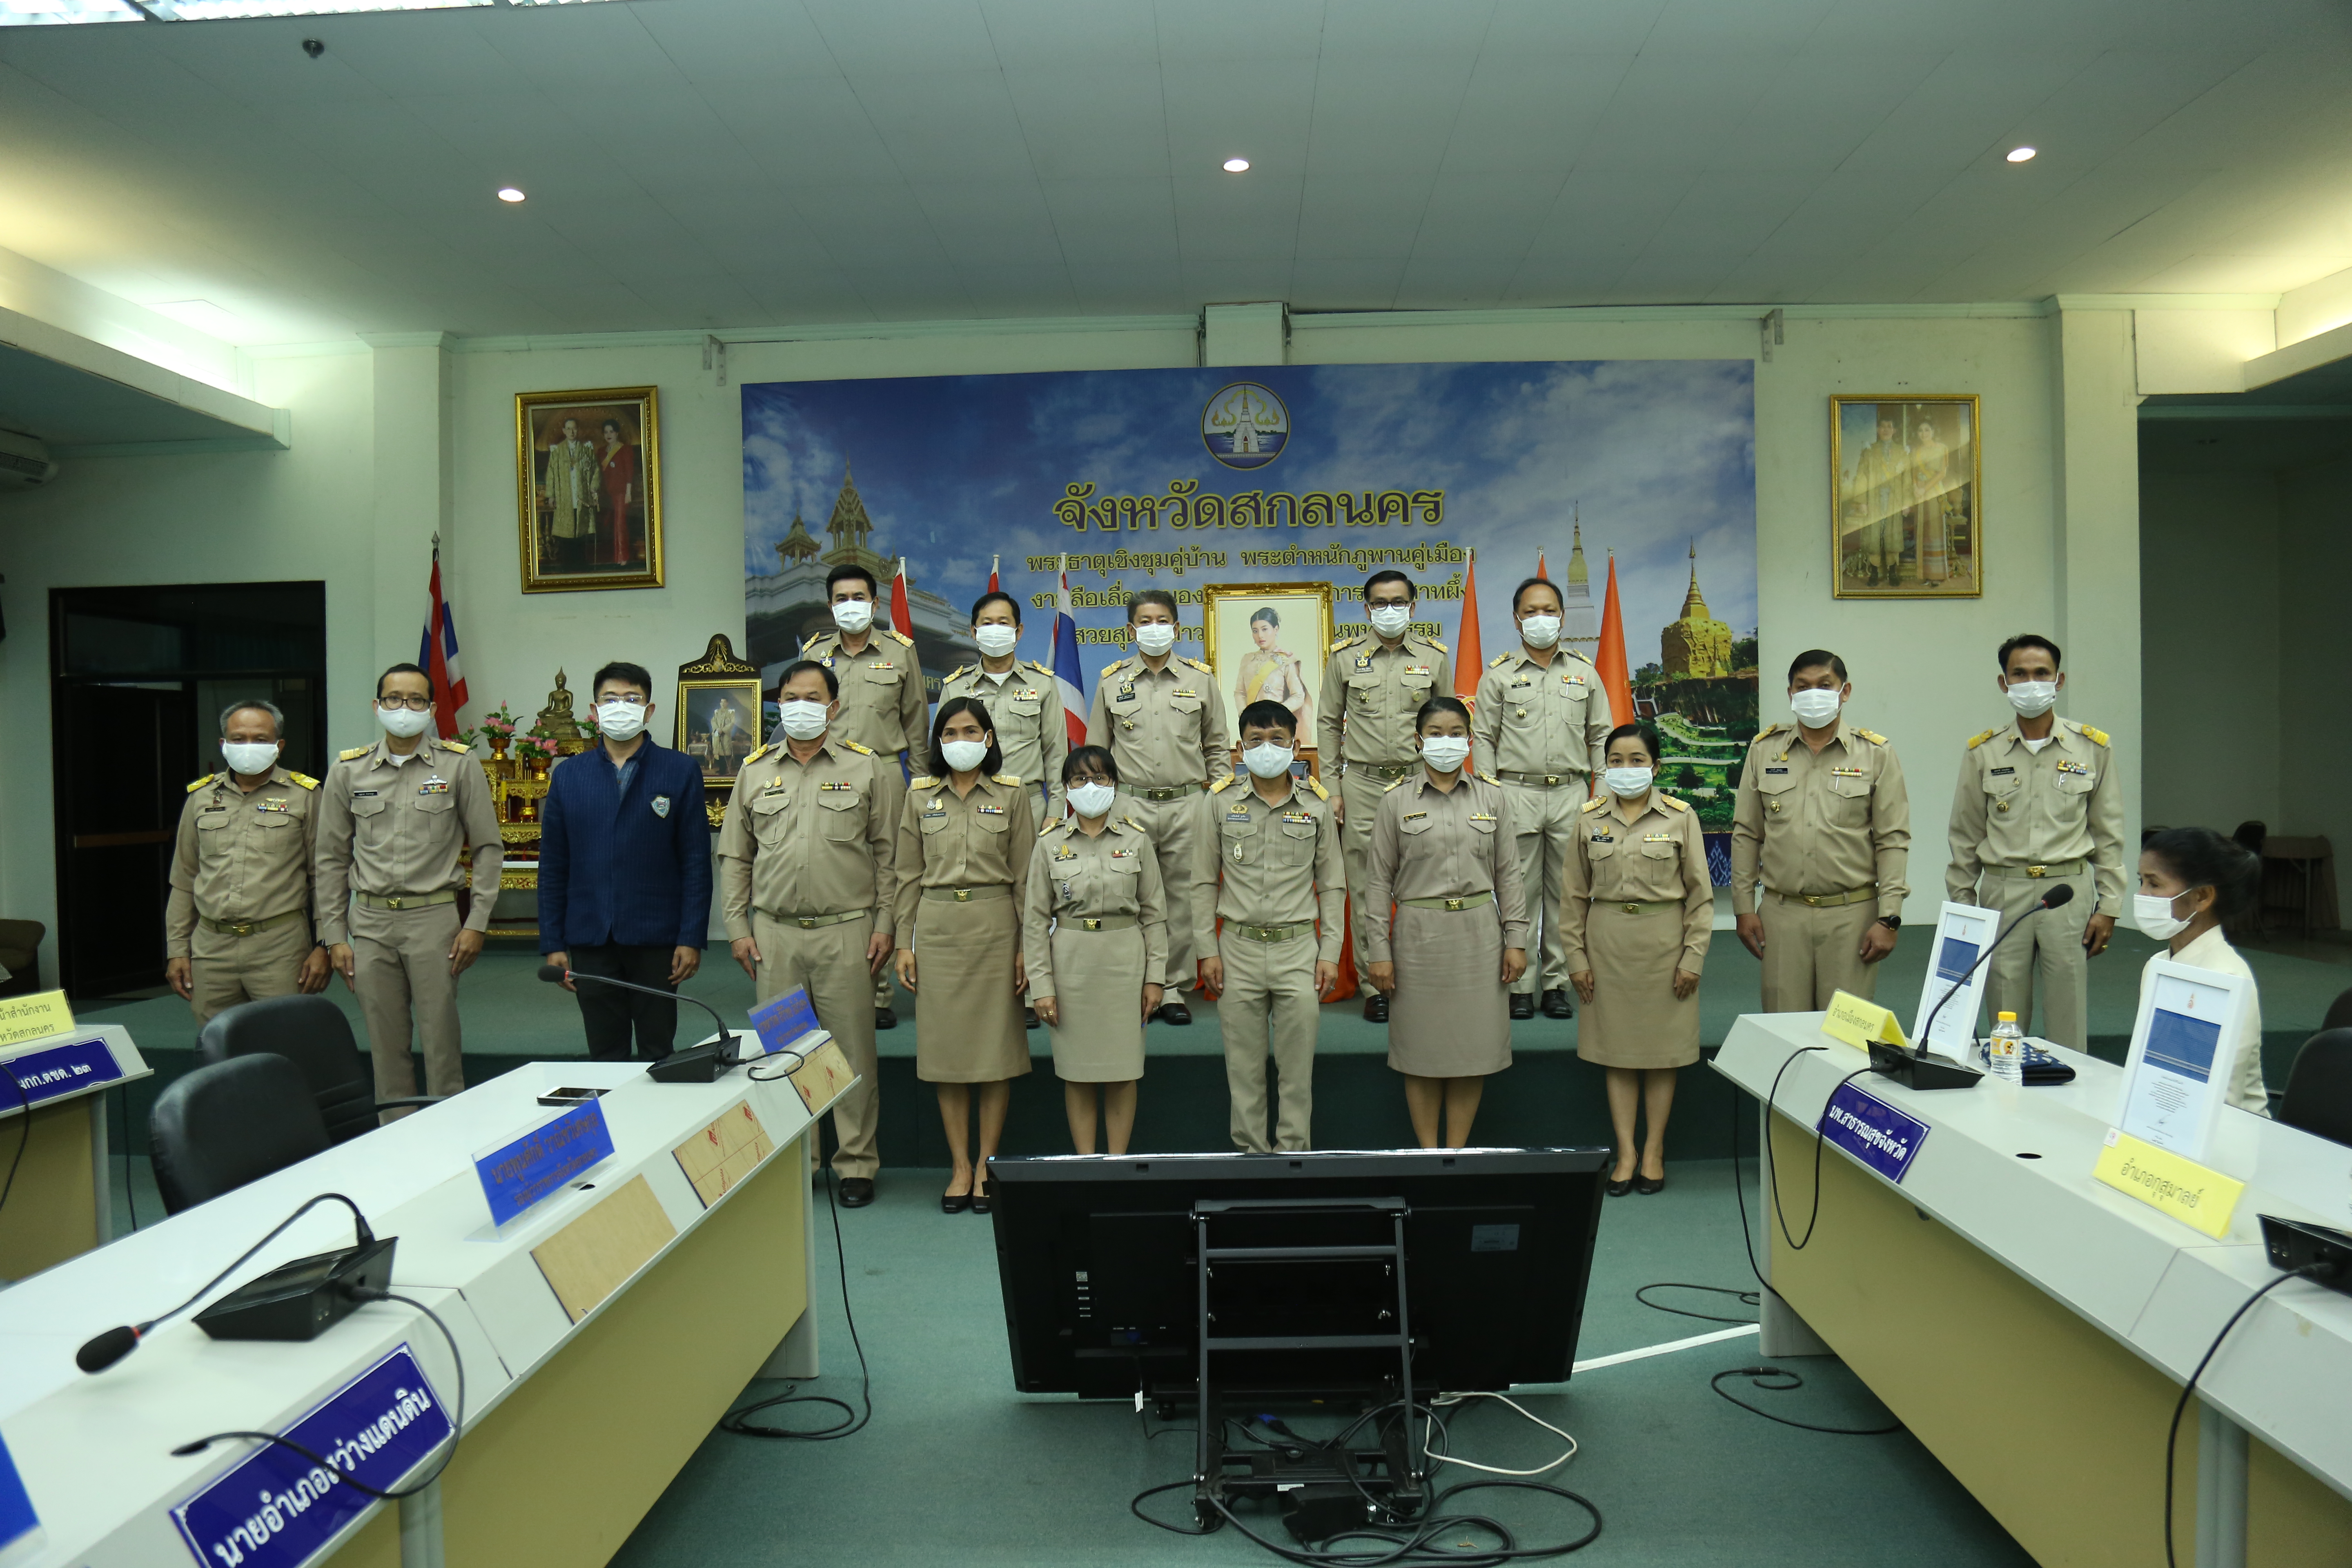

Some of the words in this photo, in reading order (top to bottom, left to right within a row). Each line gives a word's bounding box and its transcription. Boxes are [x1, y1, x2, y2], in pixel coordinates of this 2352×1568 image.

[1053, 479, 1445, 532] จังหวัดสกลนคร
[1829, 1105, 1908, 1161] นพ.สาธารณสุขจังหวัด
[2120, 1157, 2204, 1209] อำเภอกุสุมาลย์
